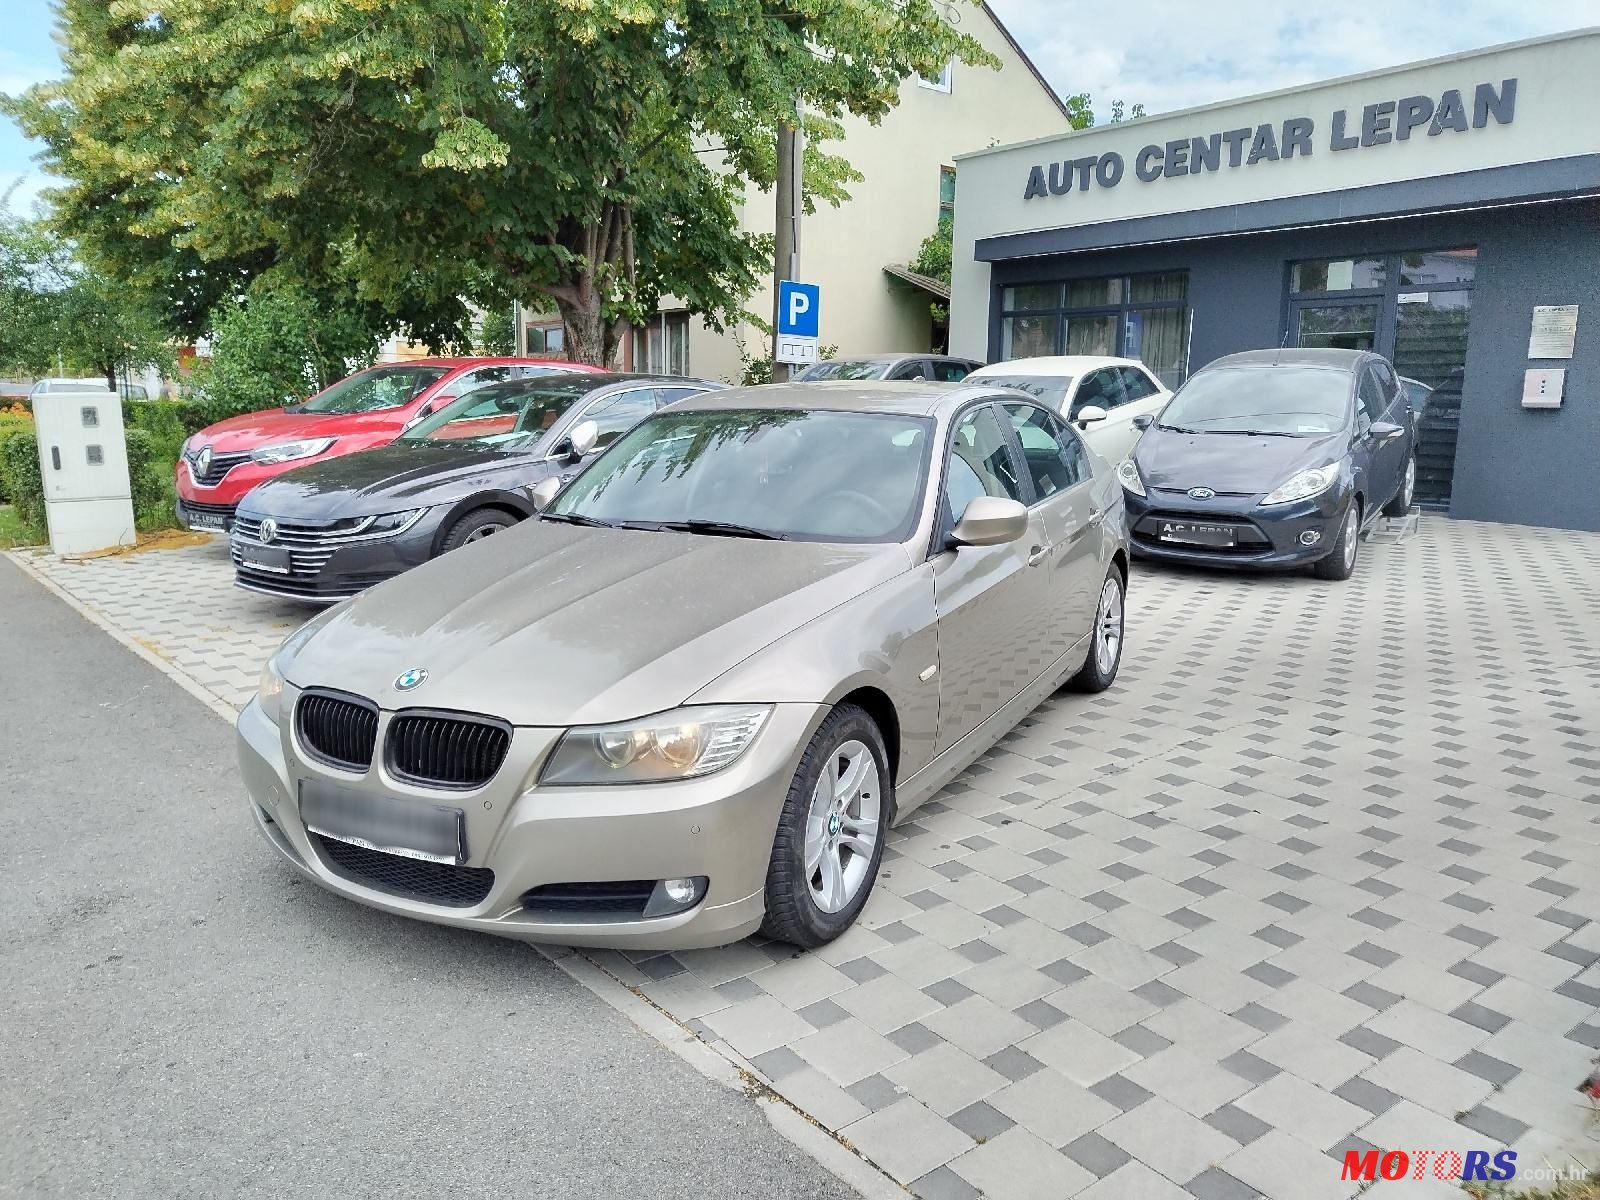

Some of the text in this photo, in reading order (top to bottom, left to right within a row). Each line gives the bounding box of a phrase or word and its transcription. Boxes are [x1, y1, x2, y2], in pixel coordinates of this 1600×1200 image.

[1024, 78, 1518, 200] AUTO CENTAR LEPAN
[789, 291, 810, 325] P
[202, 515, 224, 525] LEPAN
